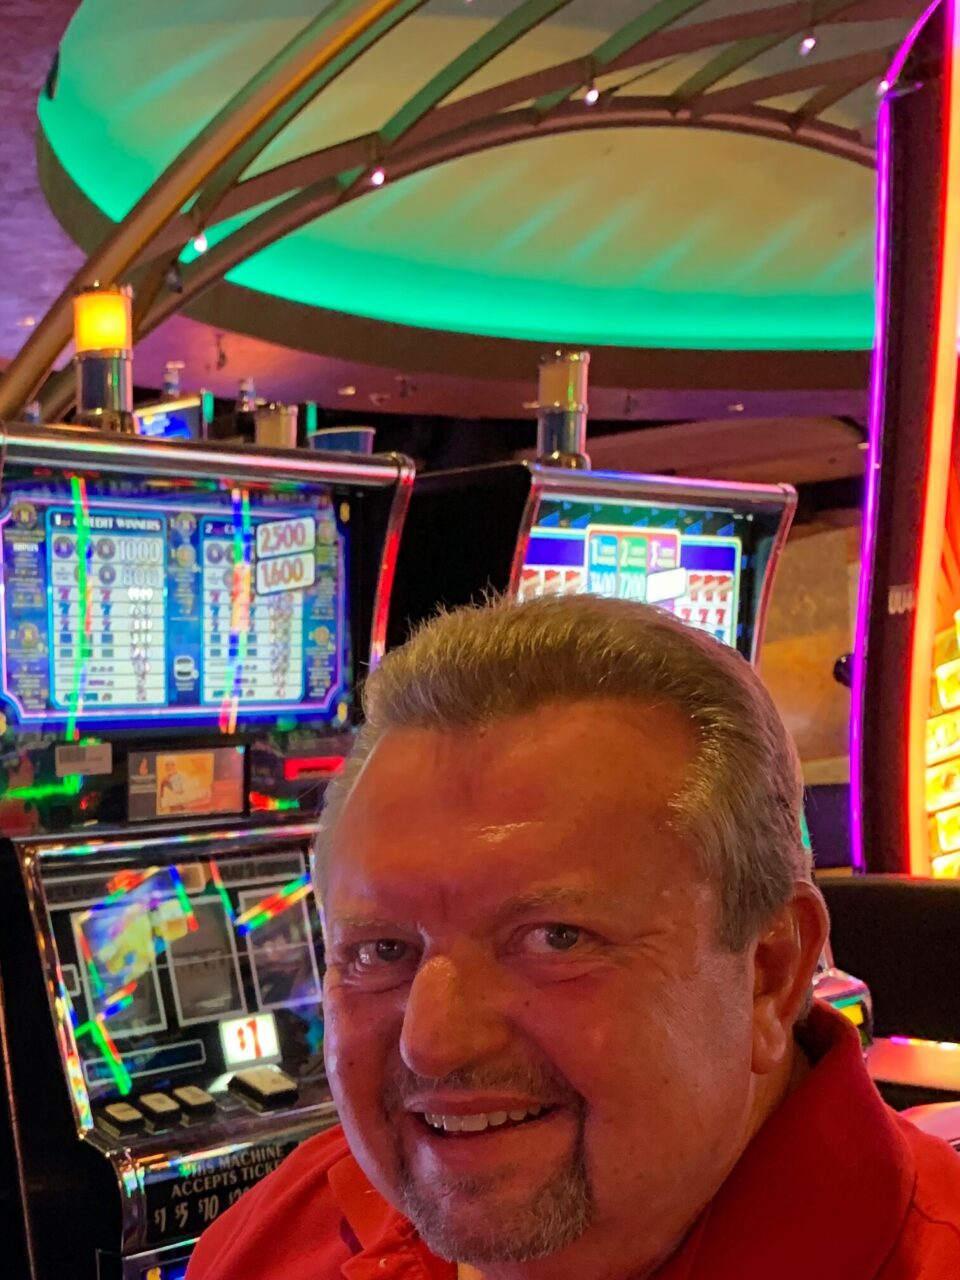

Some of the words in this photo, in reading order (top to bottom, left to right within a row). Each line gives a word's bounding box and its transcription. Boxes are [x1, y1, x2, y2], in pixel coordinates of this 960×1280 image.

[218, 1145, 283, 1169] MACHINE
[170, 1172, 238, 1199] ACCEPTS
[154, 1209, 167, 1233] $1
[175, 1202, 188, 1228] $5
[198, 1194, 219, 1222] $10
